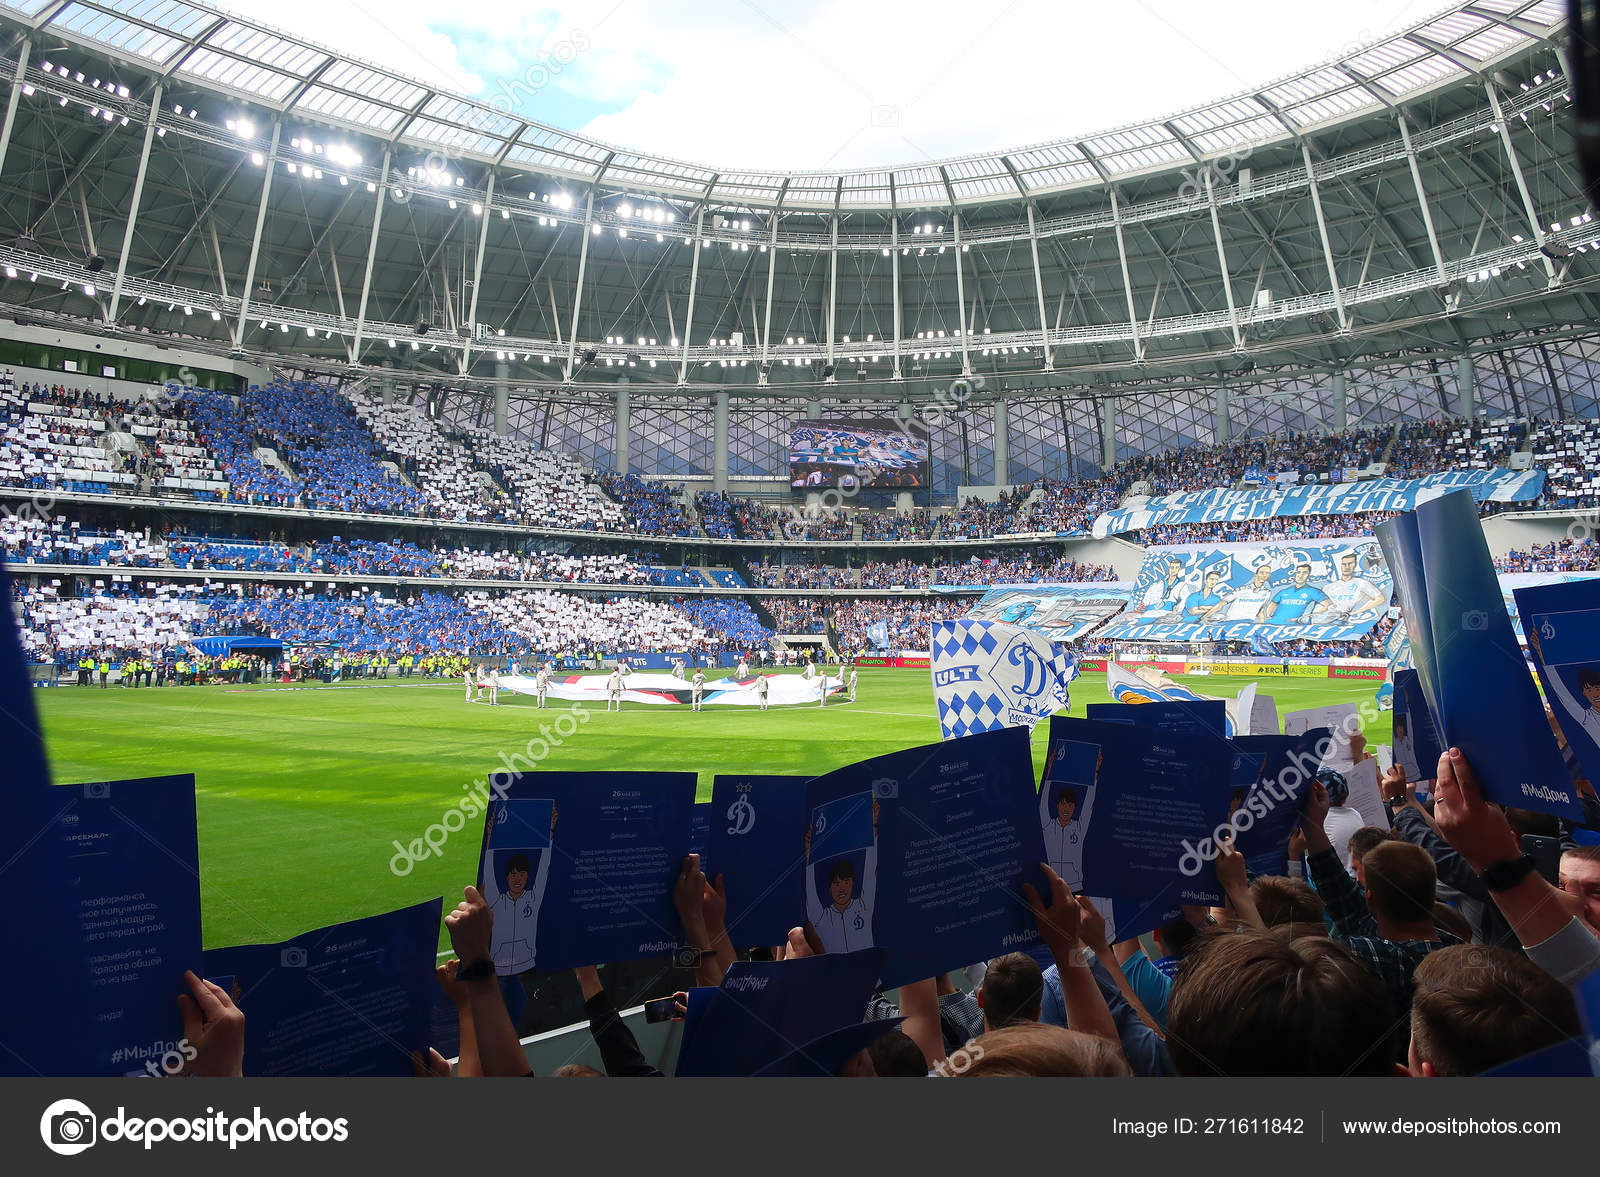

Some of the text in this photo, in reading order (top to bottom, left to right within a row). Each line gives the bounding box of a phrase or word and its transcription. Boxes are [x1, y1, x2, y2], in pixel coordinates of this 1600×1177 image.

[1303, 493, 1409, 516] ДЕНЬ
[937, 668, 973, 685] ULT
[1335, 668, 1380, 677] PHANTOM
[1521, 783, 1570, 804] #МыДома
[1181, 890, 1220, 901] #МыДома
[107, 927, 136, 938] перед
[1002, 929, 1040, 950] #МыДо
[112, 1040, 180, 1064] #МыДо
